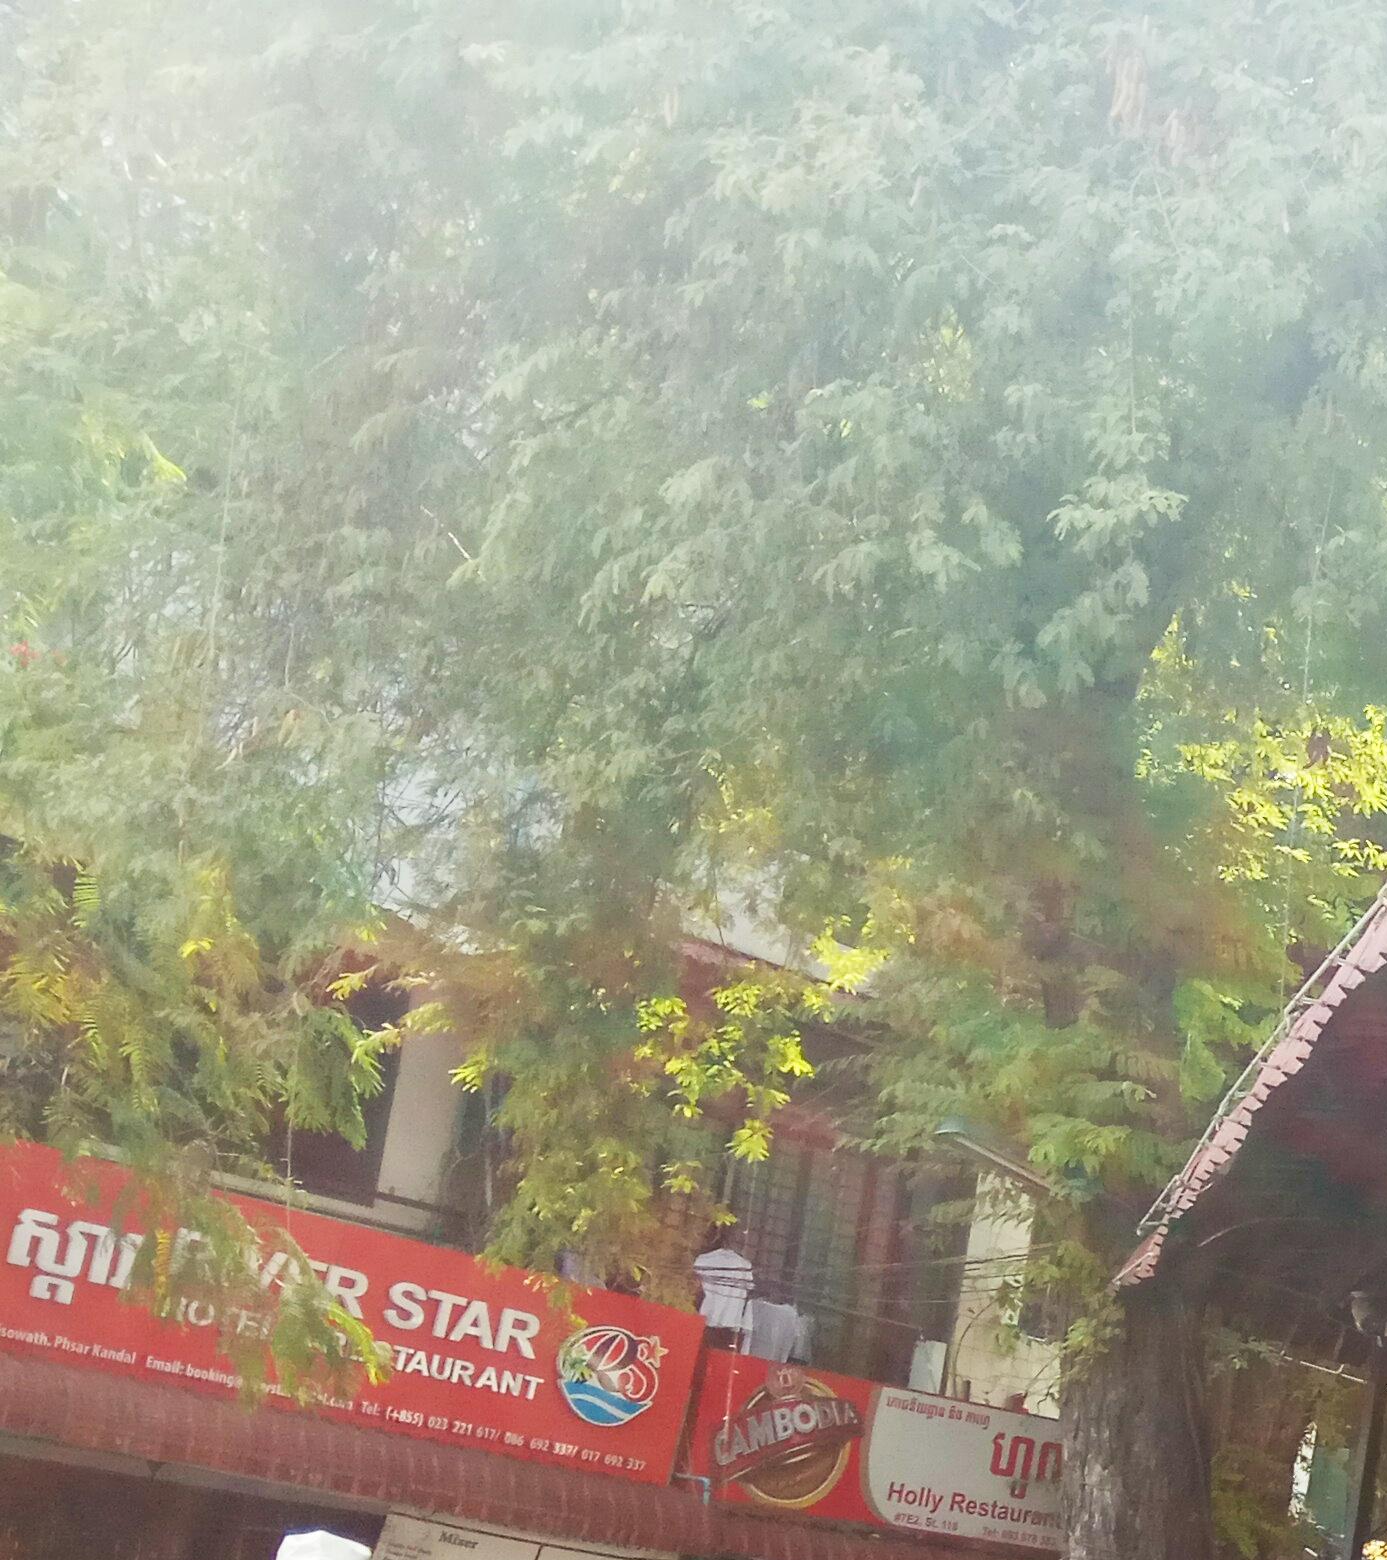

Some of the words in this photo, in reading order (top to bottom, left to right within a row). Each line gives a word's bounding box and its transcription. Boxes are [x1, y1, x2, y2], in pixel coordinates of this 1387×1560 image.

[383, 1282, 541, 1360] STAR
[54, 1335, 91, 1355] Phsar
[92, 1343, 136, 1364] Kandal
[361, 1400, 381, 1417] Tel:
[452, 1420, 473, 1436] 221
[715, 1400, 859, 1465] CAMBODIA
[887, 1481, 945, 1514] Holly
